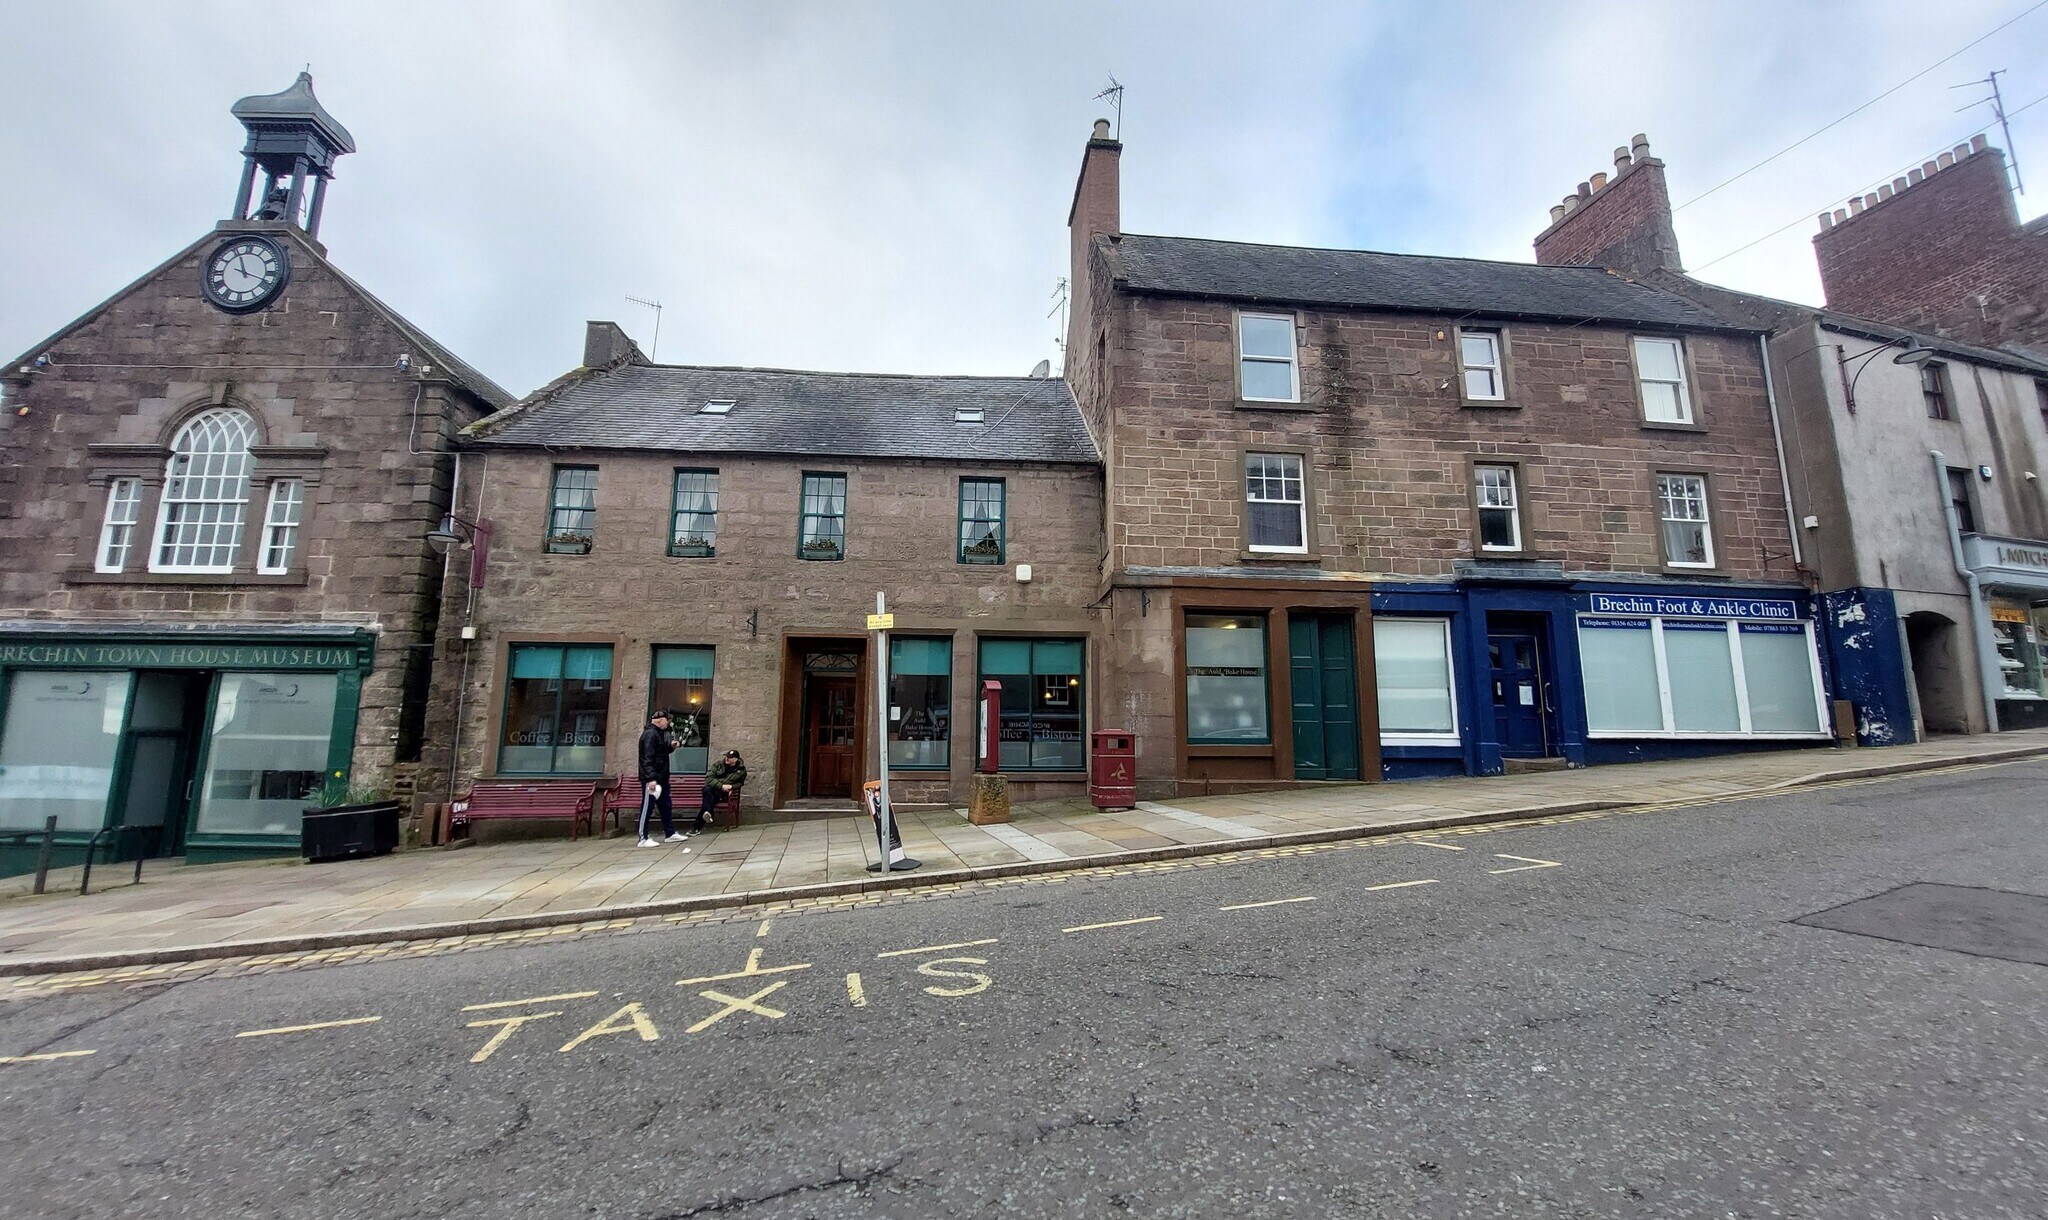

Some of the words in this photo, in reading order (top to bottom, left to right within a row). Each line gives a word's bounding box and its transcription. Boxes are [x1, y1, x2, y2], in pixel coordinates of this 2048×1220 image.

[1600, 597, 1653, 612] Brechin
[1656, 599, 1688, 614] Foot
[1691, 601, 1704, 614] &
[1707, 602, 1747, 616] Ankle
[1750, 603, 1790, 617] Clinic
[0, 646, 87, 662] RECHIN
[96, 647, 161, 663] TOWN
[169, 648, 244, 664] HOUSE
[249, 649, 352, 665] MUSEUM
[509, 731, 550, 743] Coffee
[564, 732, 600, 743] Bistro
[1042, 729, 1073, 740] Bistro
[467, 956, 994, 1063] TAXIS
